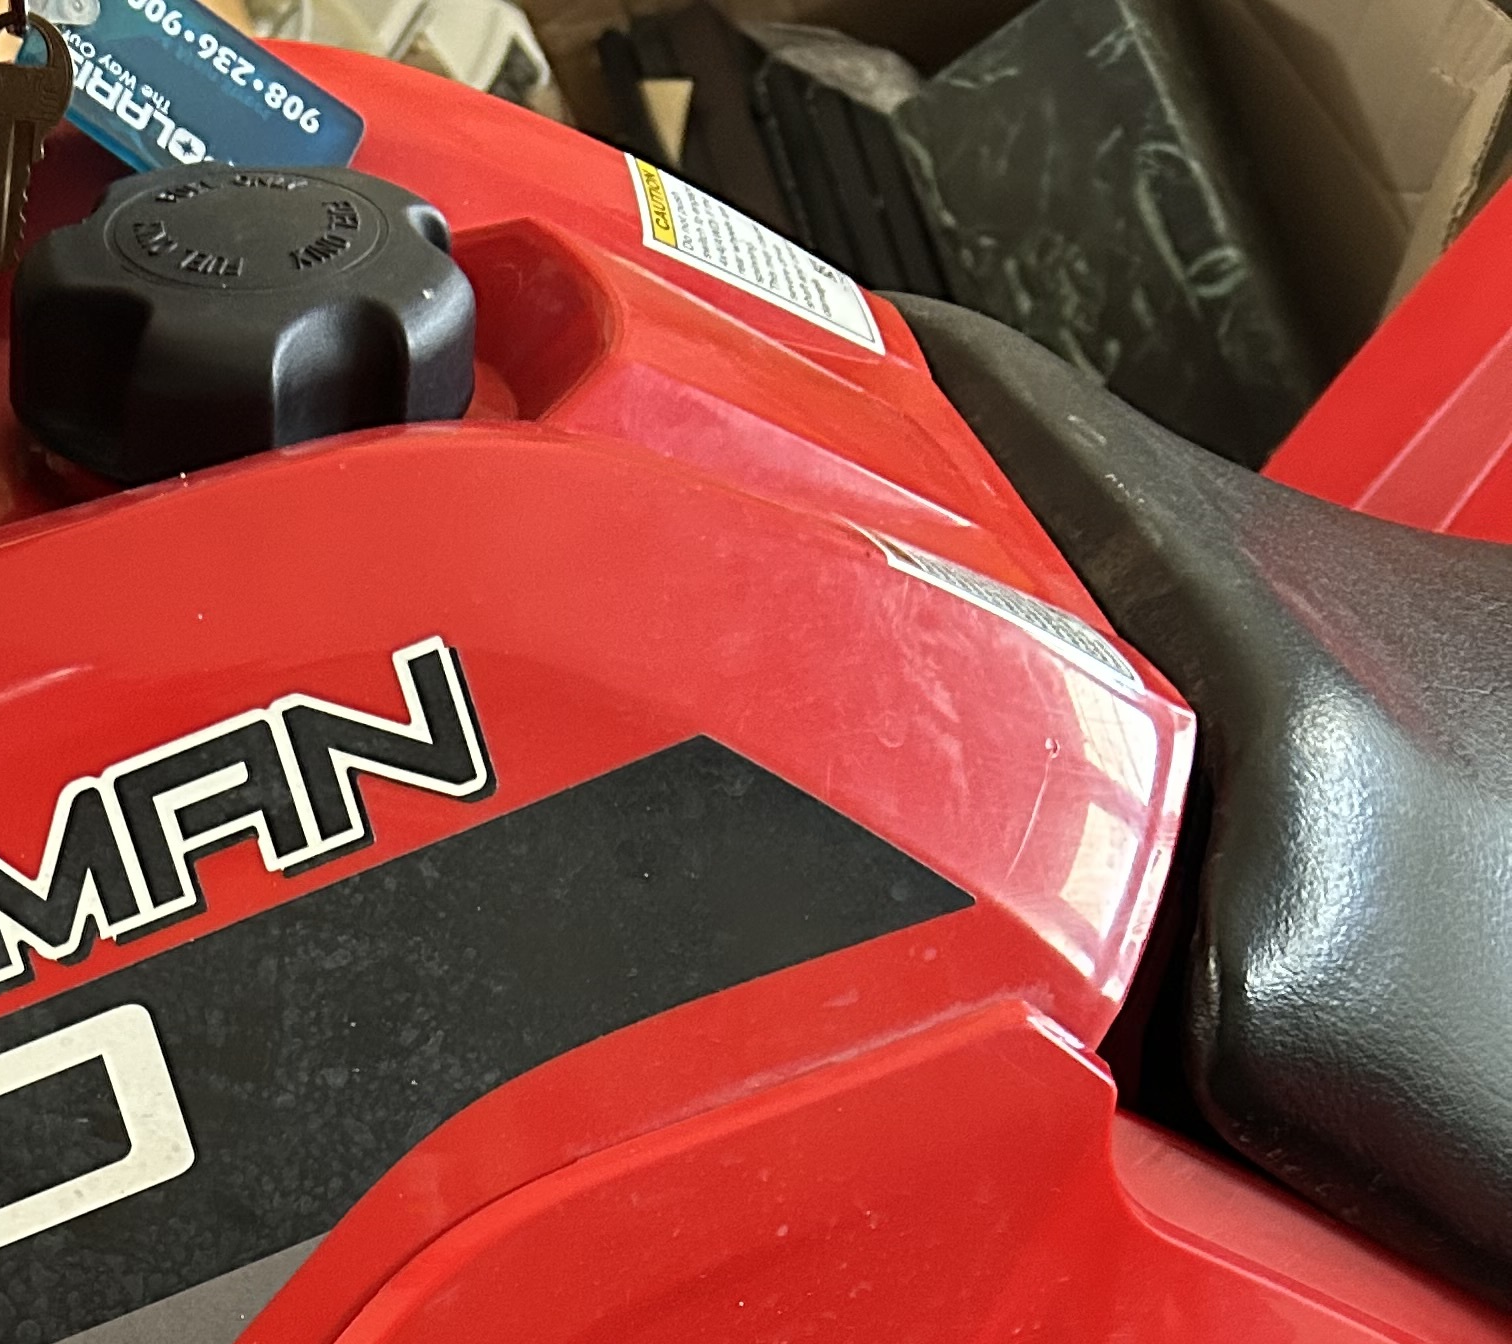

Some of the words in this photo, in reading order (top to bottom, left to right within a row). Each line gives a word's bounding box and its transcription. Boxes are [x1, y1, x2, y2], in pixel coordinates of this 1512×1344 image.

[98, 52, 138, 89] Way
[142, 83, 171, 115] The
[641, 168, 671, 231] CAUTION
